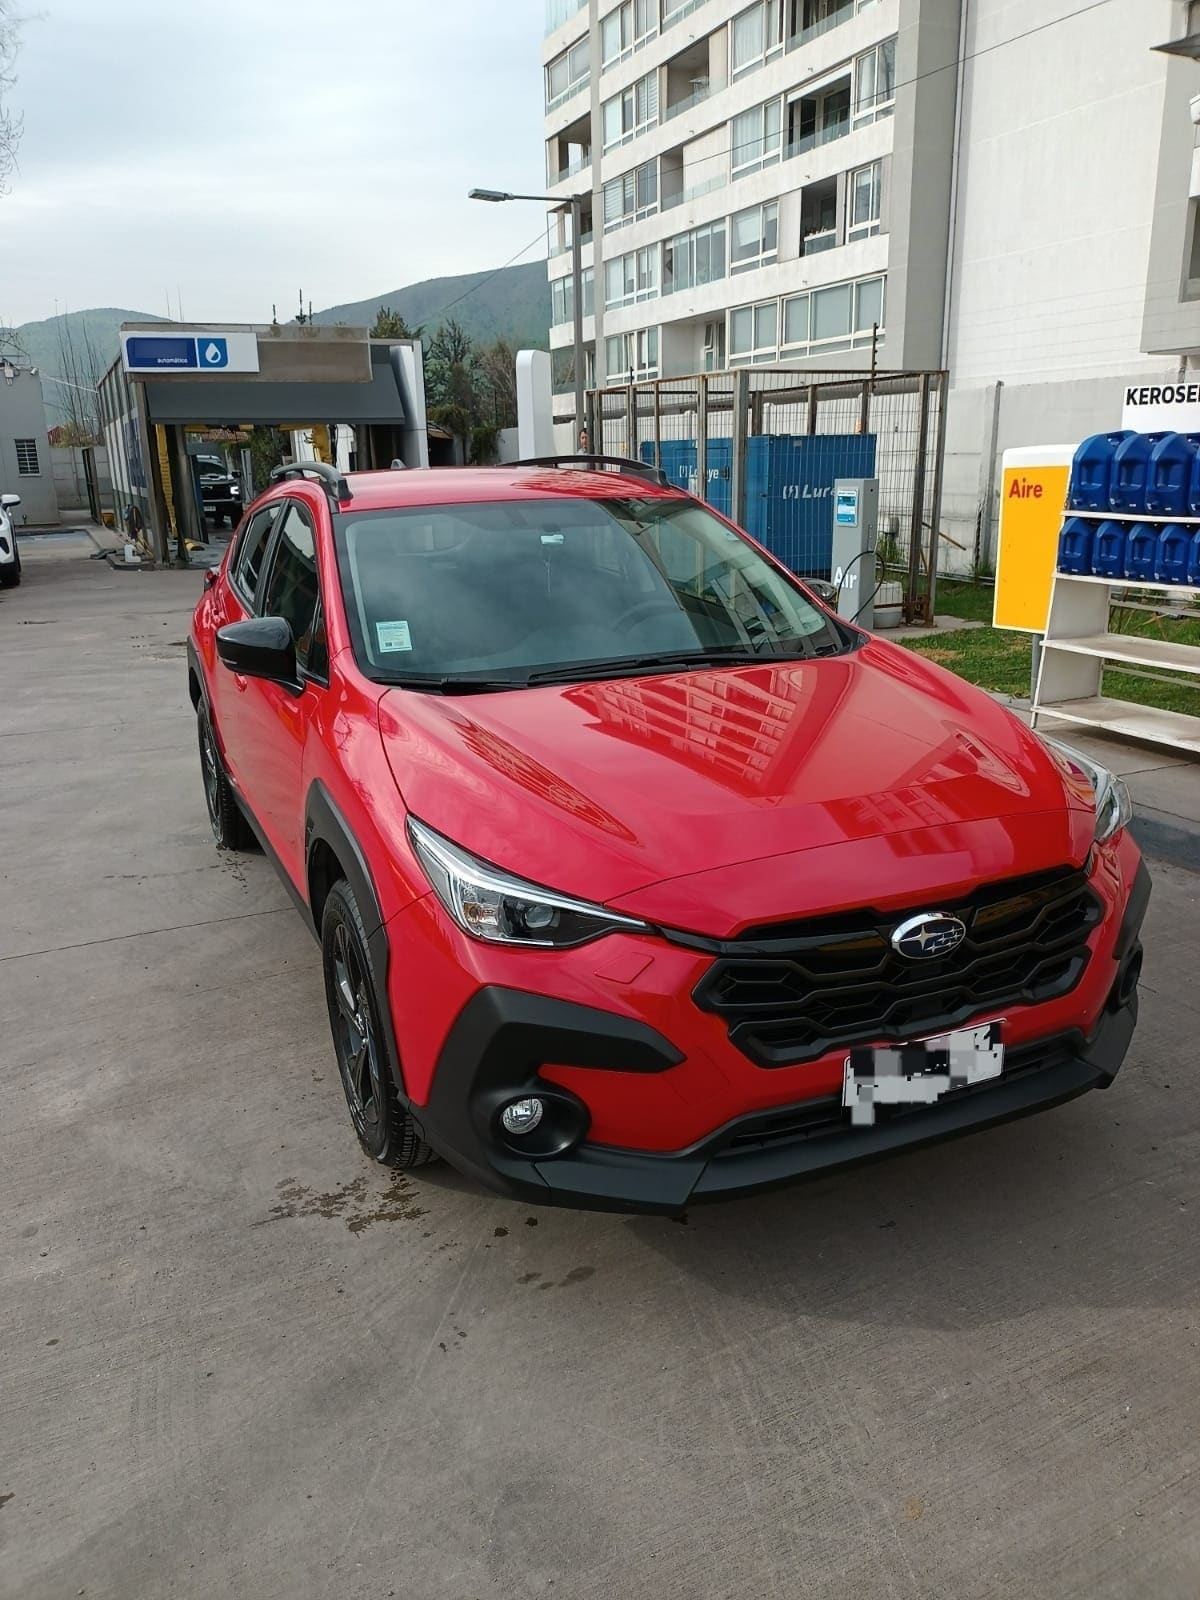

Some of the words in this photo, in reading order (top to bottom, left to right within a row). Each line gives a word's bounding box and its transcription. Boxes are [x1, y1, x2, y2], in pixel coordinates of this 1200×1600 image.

[1126, 384, 1200, 405] KEROSE
[1009, 478, 1043, 499] Aire
[834, 566, 857, 588] Air
